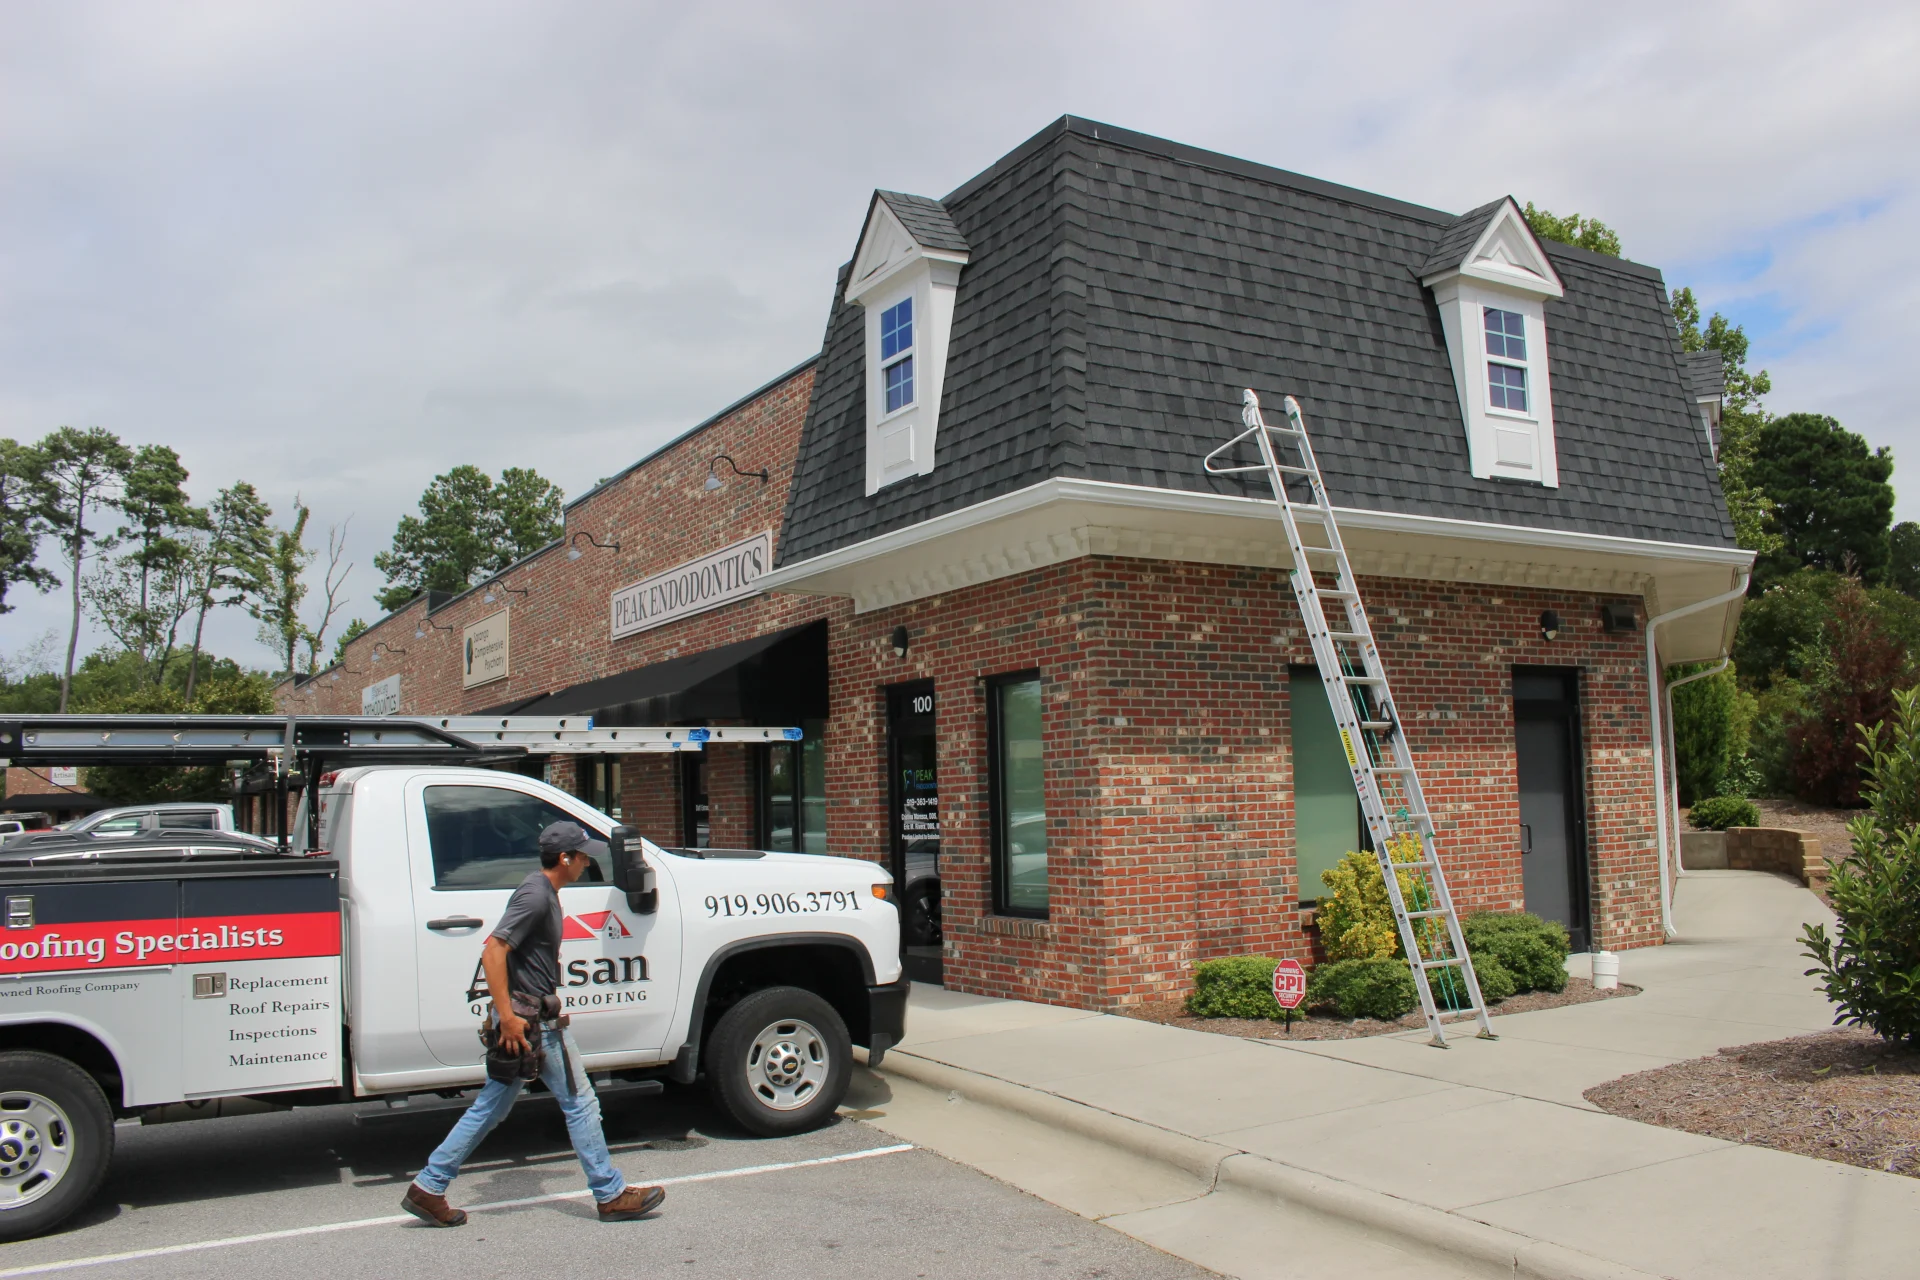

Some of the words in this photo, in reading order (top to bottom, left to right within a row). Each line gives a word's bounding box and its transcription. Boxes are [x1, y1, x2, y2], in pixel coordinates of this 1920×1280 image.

[615, 590, 647, 629] PEAK
[650, 546, 762, 617] ENDODONTICS
[474, 638, 504, 660] Comprehensive
[484, 654, 504, 672] Psychiatry
[913, 695, 932, 713] 100
[916, 769, 933, 781] PEAK
[906, 797, 938, 806] 919-363-1419
[705, 890, 862, 918] 919.906.3791
[115, 925, 284, 960] Specialists
[36, 983, 82, 996] Roofing
[84, 981, 140, 993] Company
[229, 975, 329, 992] Replacement
[1276, 974, 1302, 992] CPI
[229, 1001, 267, 1016] Roof
[272, 999, 330, 1014] Repairs
[565, 989, 648, 1008] ROOFING
[229, 1025, 317, 1043] Inspections
[229, 1051, 328, 1067] Maintenance
